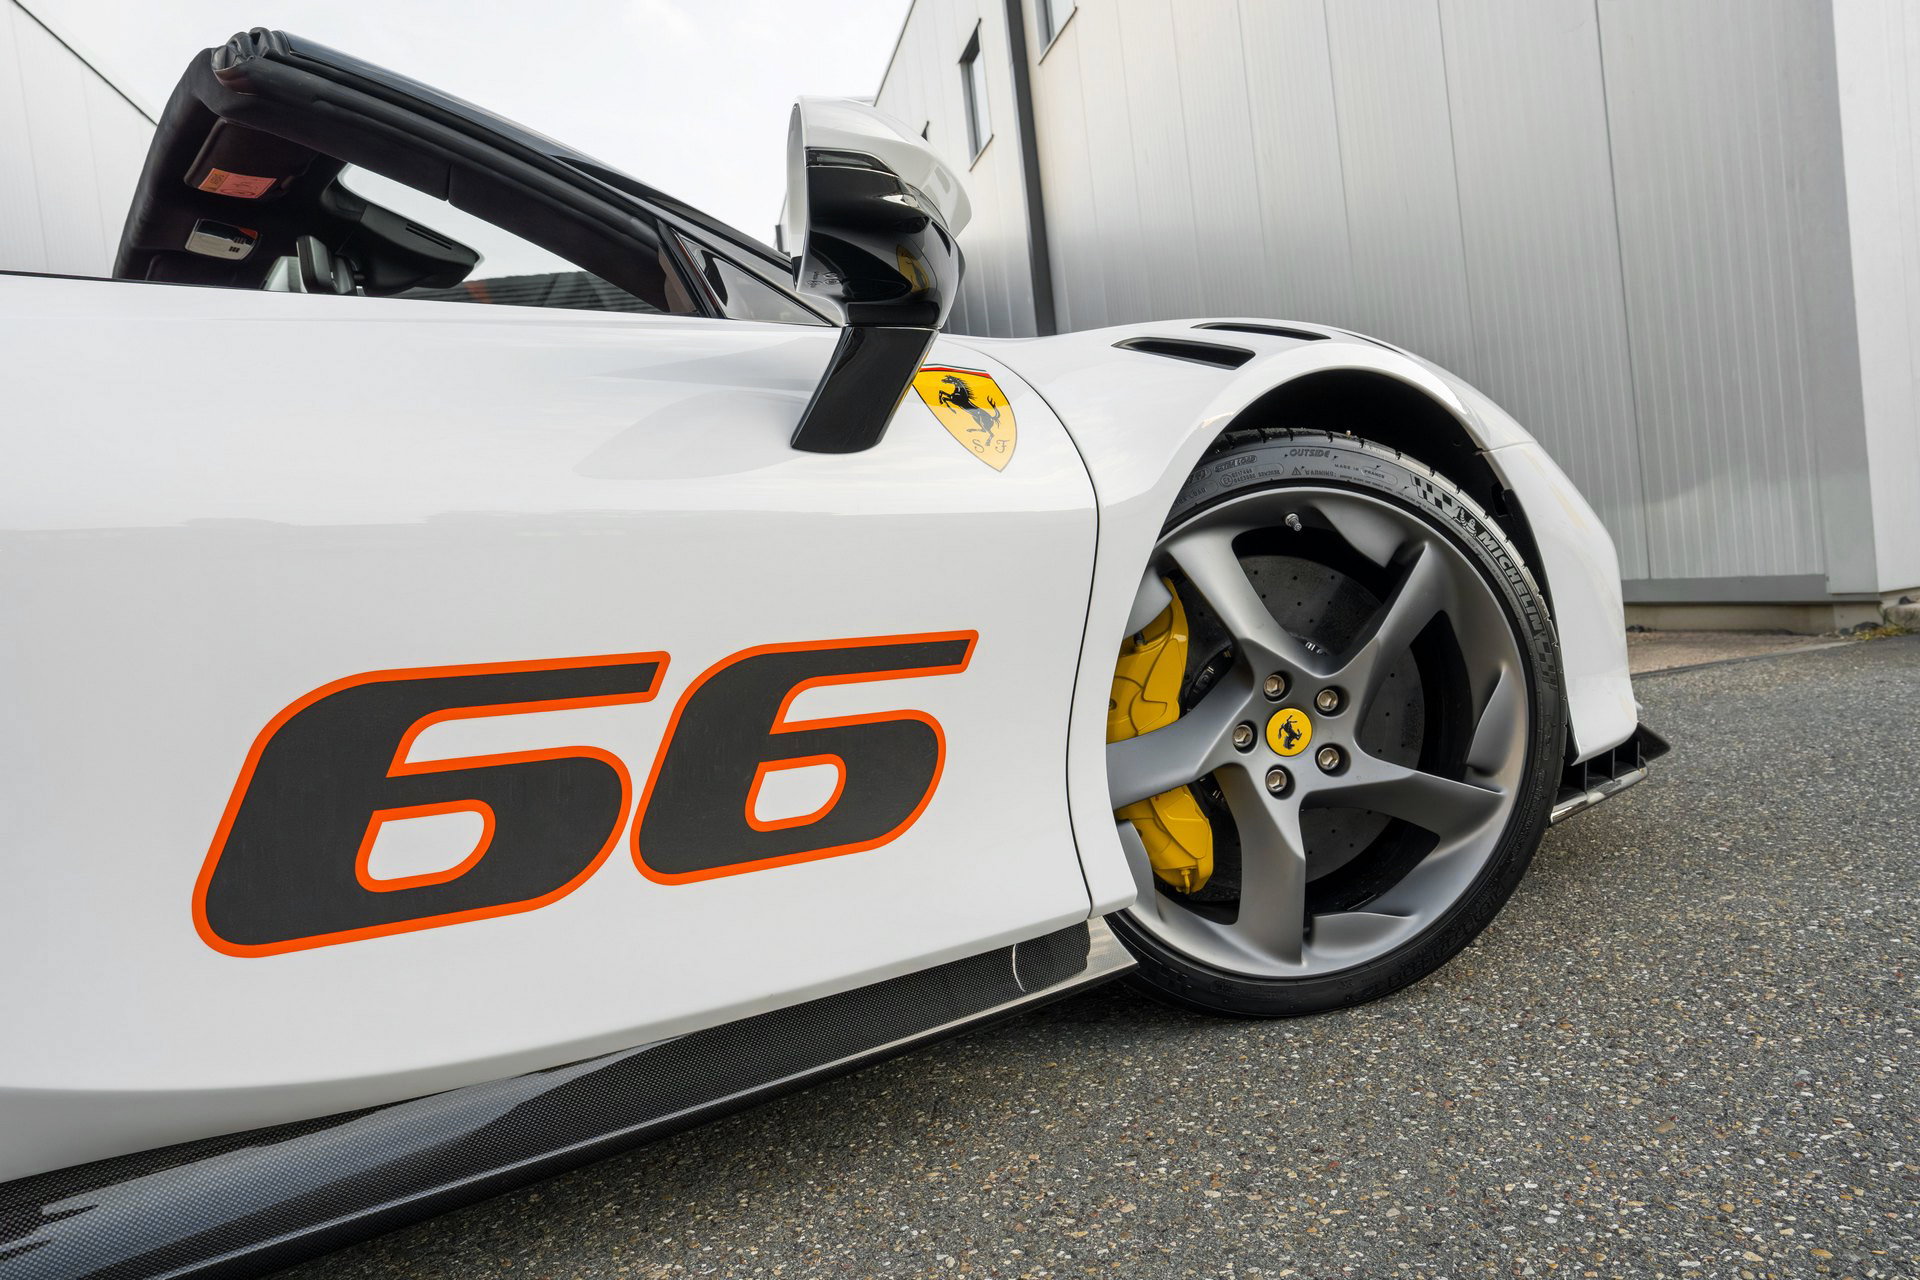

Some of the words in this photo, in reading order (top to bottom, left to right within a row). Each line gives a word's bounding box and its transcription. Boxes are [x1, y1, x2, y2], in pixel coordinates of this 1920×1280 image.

[972, 439, 984, 453] S
[995, 439, 1010, 453] F
[1289, 449, 1331, 458] OUTSIDE
[1478, 531, 1545, 631] MICHELIN
[191, 629, 979, 958] 66
